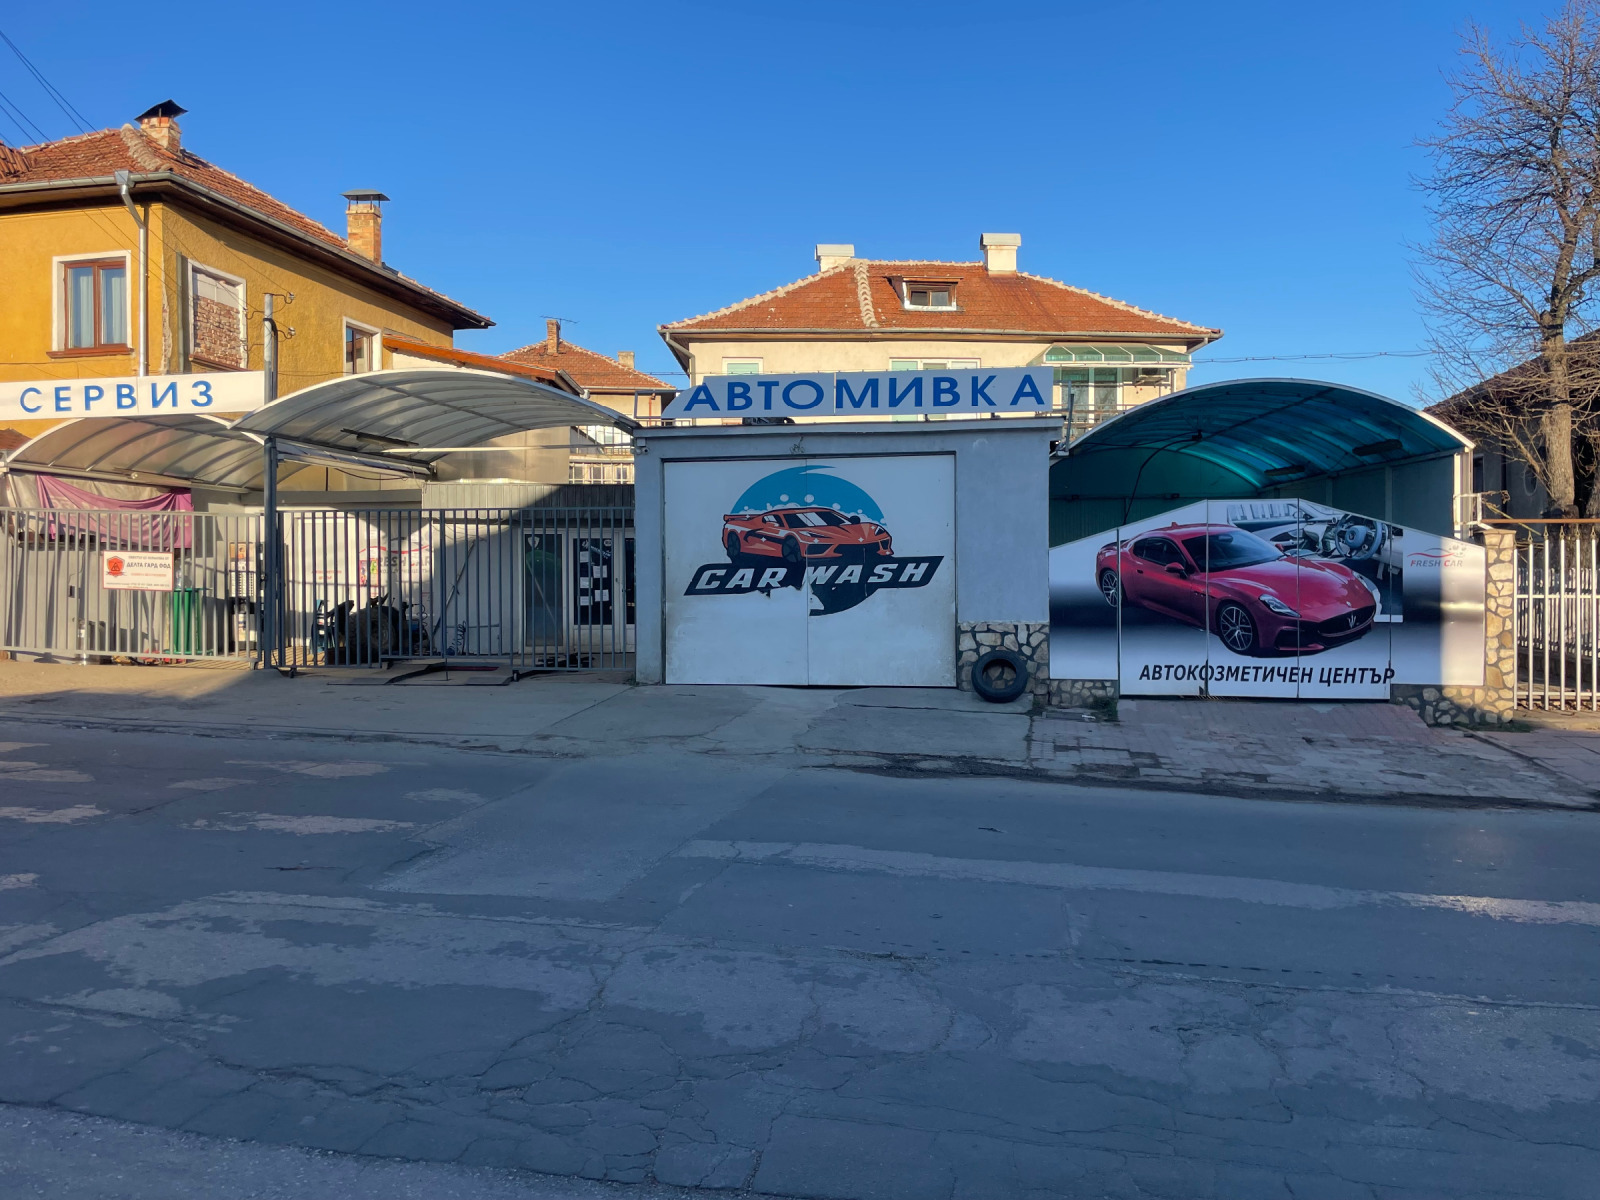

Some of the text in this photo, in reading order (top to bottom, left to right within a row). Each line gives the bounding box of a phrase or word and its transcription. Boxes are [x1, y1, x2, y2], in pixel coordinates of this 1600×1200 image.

[20, 380, 214, 413] СЕРВИЗ
[683, 374, 1045, 412] АВТОМИВКА
[695, 562, 929, 590] CAR WASH
[1410, 559, 1463, 567] FRESH CAR
[1139, 664, 1395, 687] АВТОКОЗМЕТИЧЕН ЦЕНТЪР
